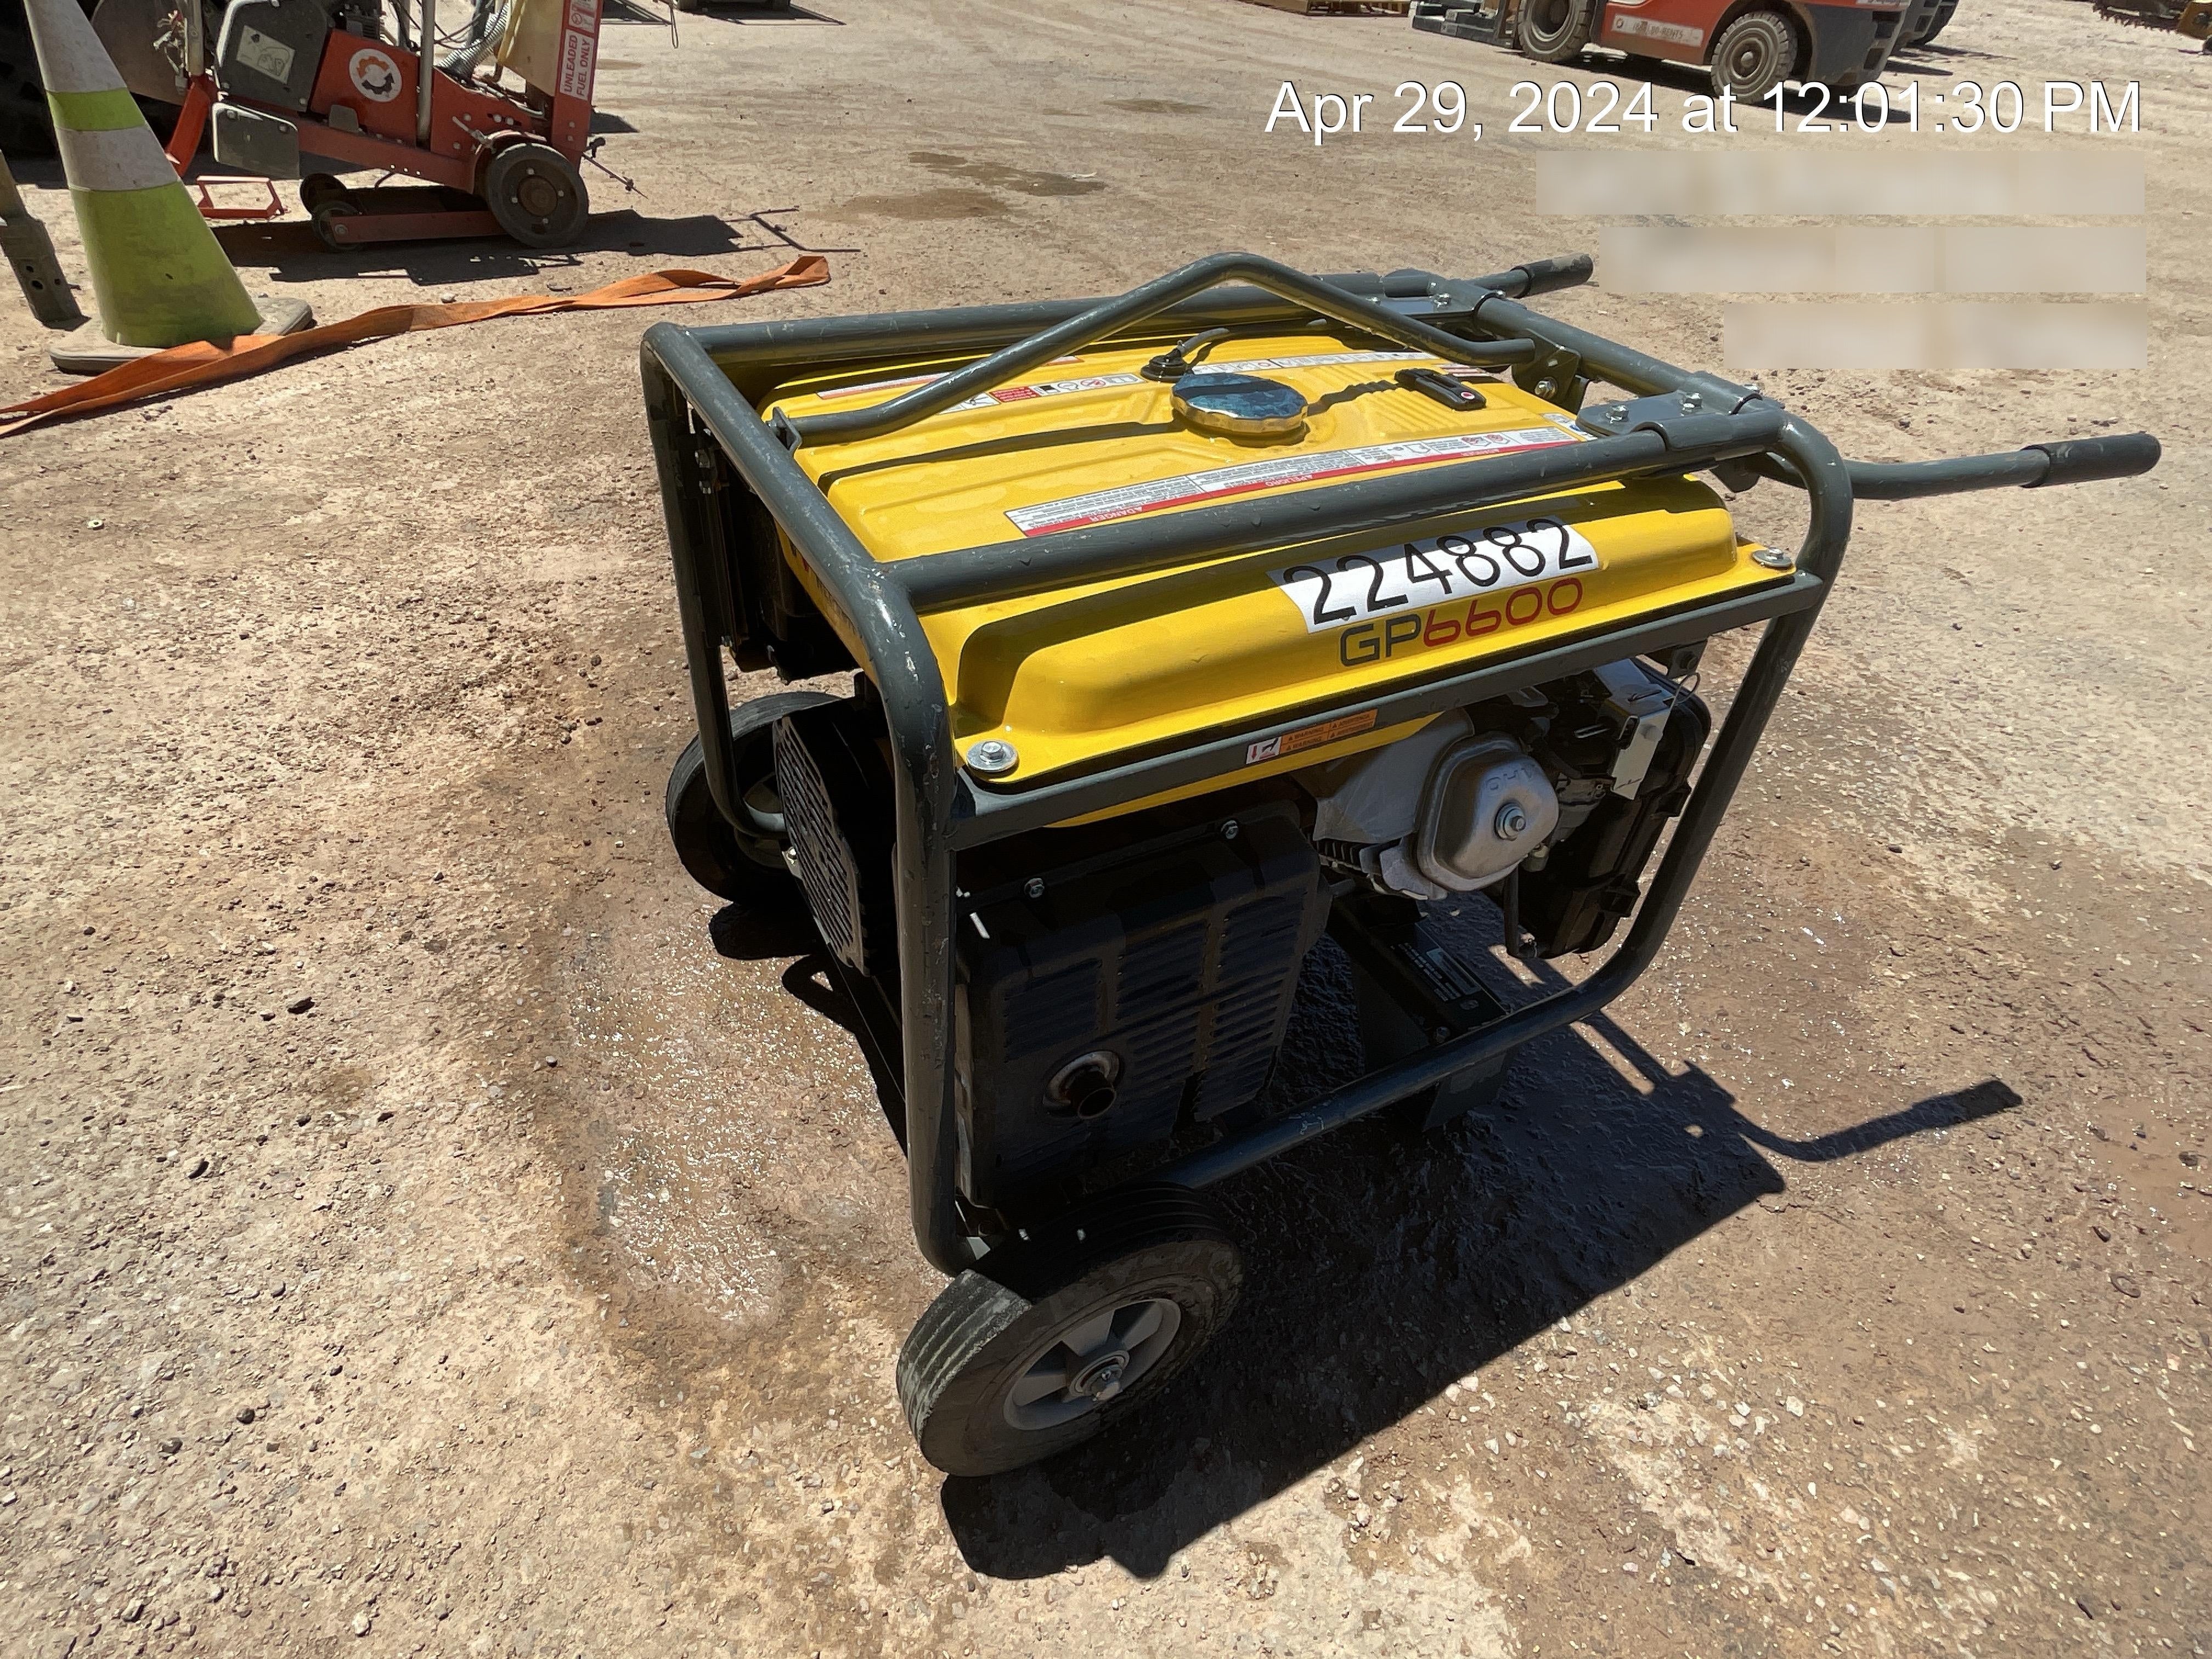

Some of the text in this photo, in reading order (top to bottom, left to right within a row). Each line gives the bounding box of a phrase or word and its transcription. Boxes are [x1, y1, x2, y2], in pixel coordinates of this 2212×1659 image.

[564, 35, 578, 92] UNLEADED
[577, 39, 590, 97] FUEL ONLY
[1265, 476, 1308, 487] PELIGRO
[1090, 508, 1136, 522] DANGER
[1283, 518, 1593, 625] 224882
[1340, 577, 1583, 667] GP6600
[1292, 736, 1322, 749] WARNING
[1294, 726, 1324, 740] WARNING
